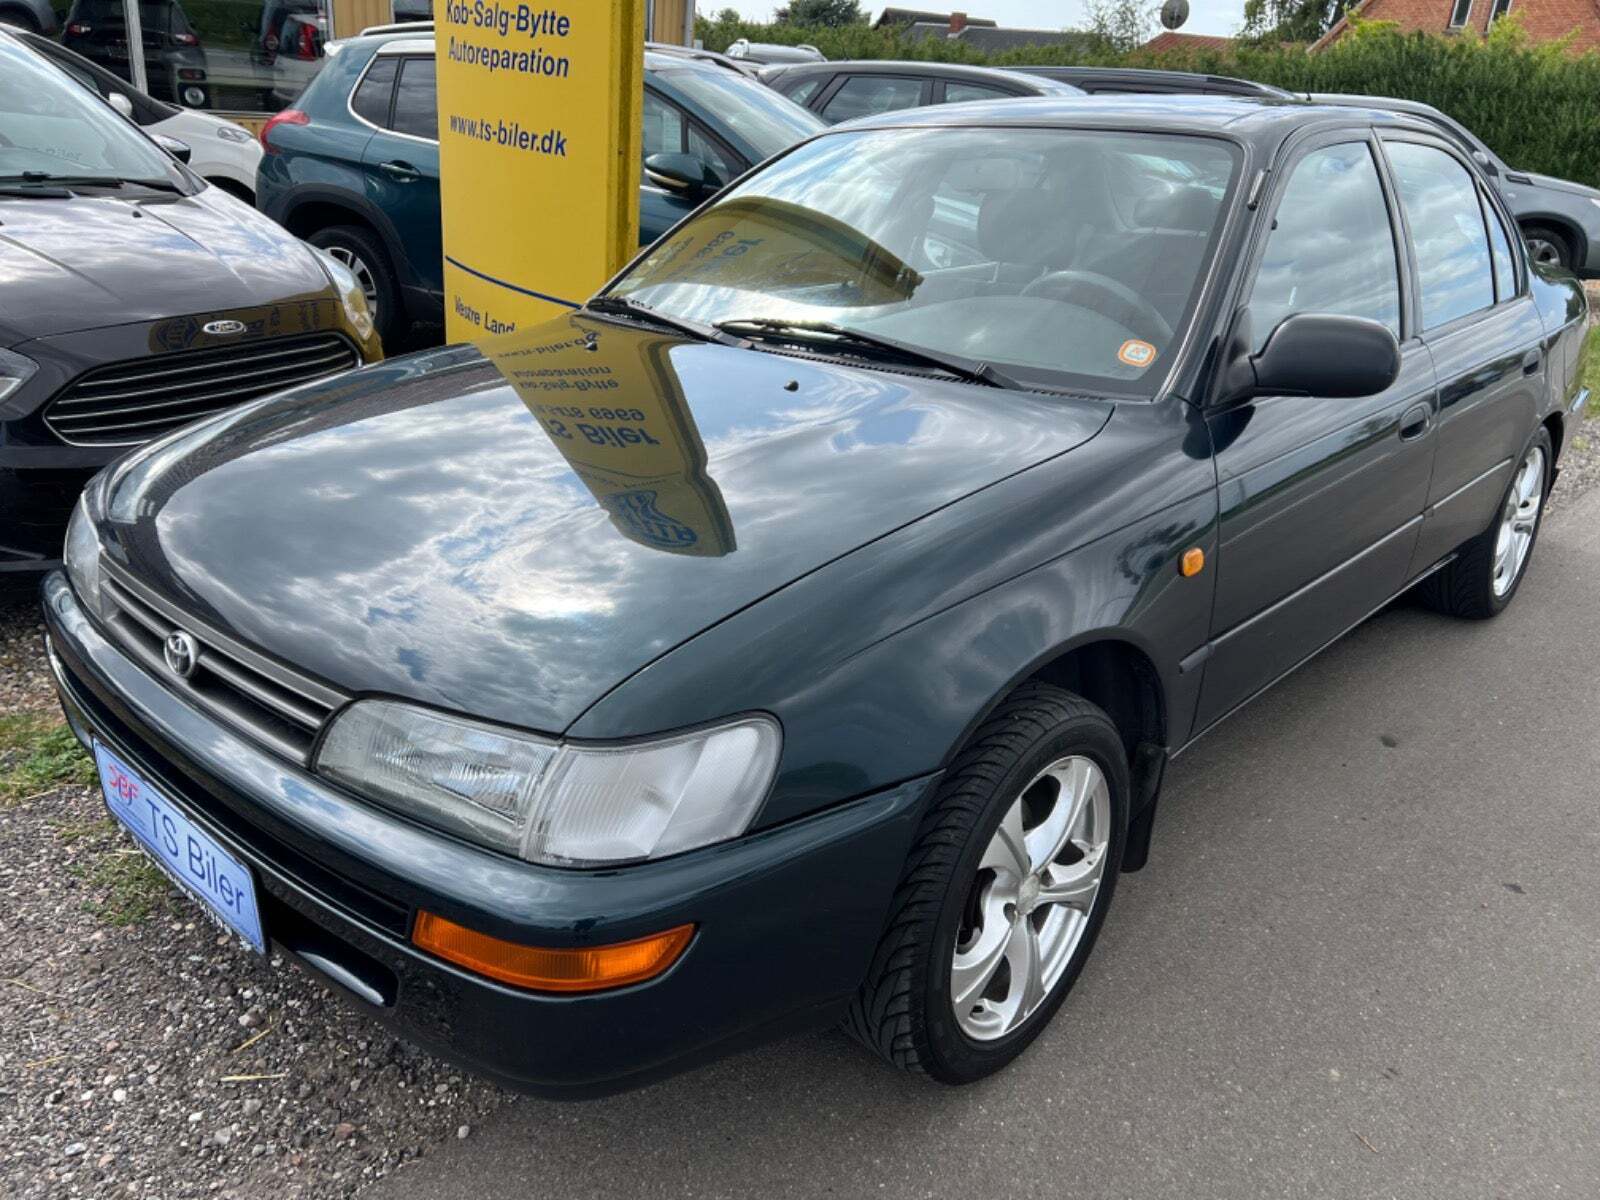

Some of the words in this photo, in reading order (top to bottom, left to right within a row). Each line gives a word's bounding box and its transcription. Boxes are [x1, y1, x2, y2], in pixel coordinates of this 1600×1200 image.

[449, 36, 569, 77] Autoreparation
[450, 114, 567, 156] www.ts-biler.dk
[145, 797, 179, 858] TS
[187, 833, 244, 914] Biler
